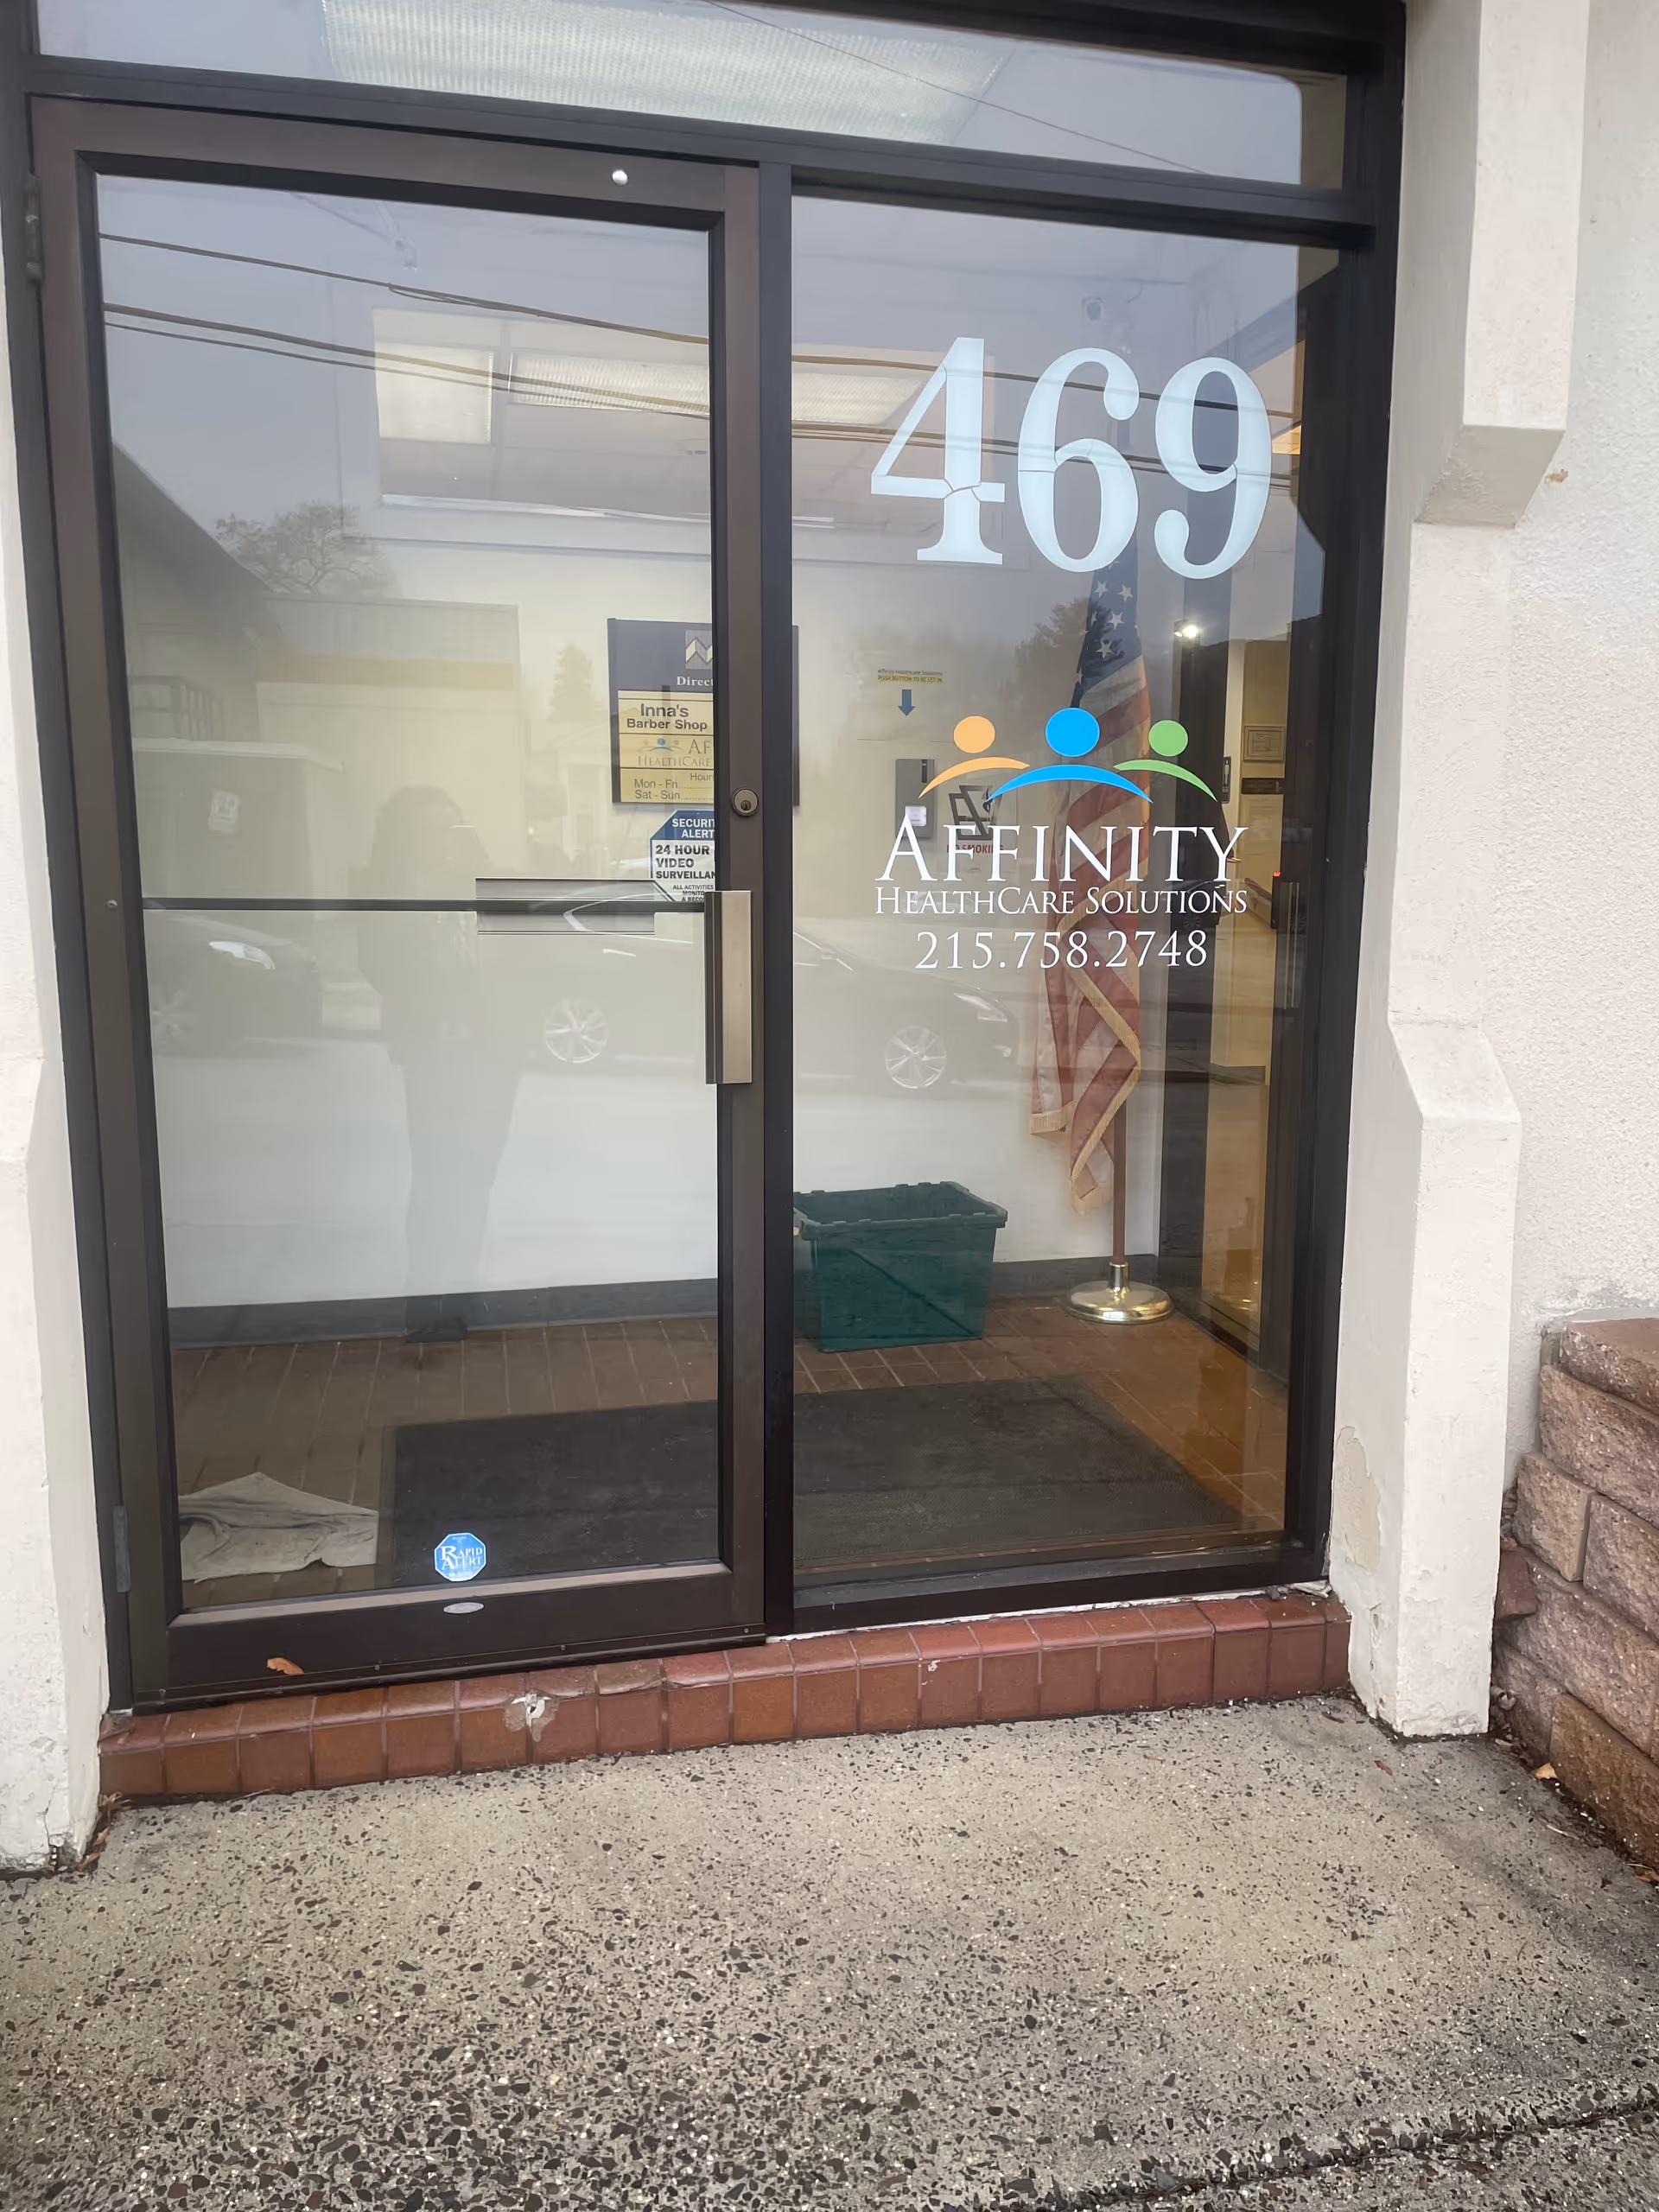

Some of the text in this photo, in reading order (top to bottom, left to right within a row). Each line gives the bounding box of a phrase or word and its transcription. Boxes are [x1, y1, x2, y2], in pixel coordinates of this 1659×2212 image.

[871, 337, 1272, 579] 469
[640, 702, 689, 717] Inna's
[626, 718, 708, 732] Barber Shop
[690, 772, 714, 781] Hour
[634, 779, 656, 789] Mon
[665, 779, 678, 789] Fri
[635, 790, 652, 799] Sat
[661, 791, 680, 800] Sun
[681, 829, 715, 838] ALERT
[655, 844, 710, 855] 24 HOUR
[875, 814, 1248, 882] AFFINITY
[962, 843, 1004, 854] SMOKI
[655, 858, 695, 868] VIDEO
[875, 887, 1248, 914] HEALTHCARE SOLUTIONS
[914, 929, 1208, 969] 215.758.2748
[441, 1545, 483, 1560] RAPID
[441, 1555, 482, 1570] ALERT
